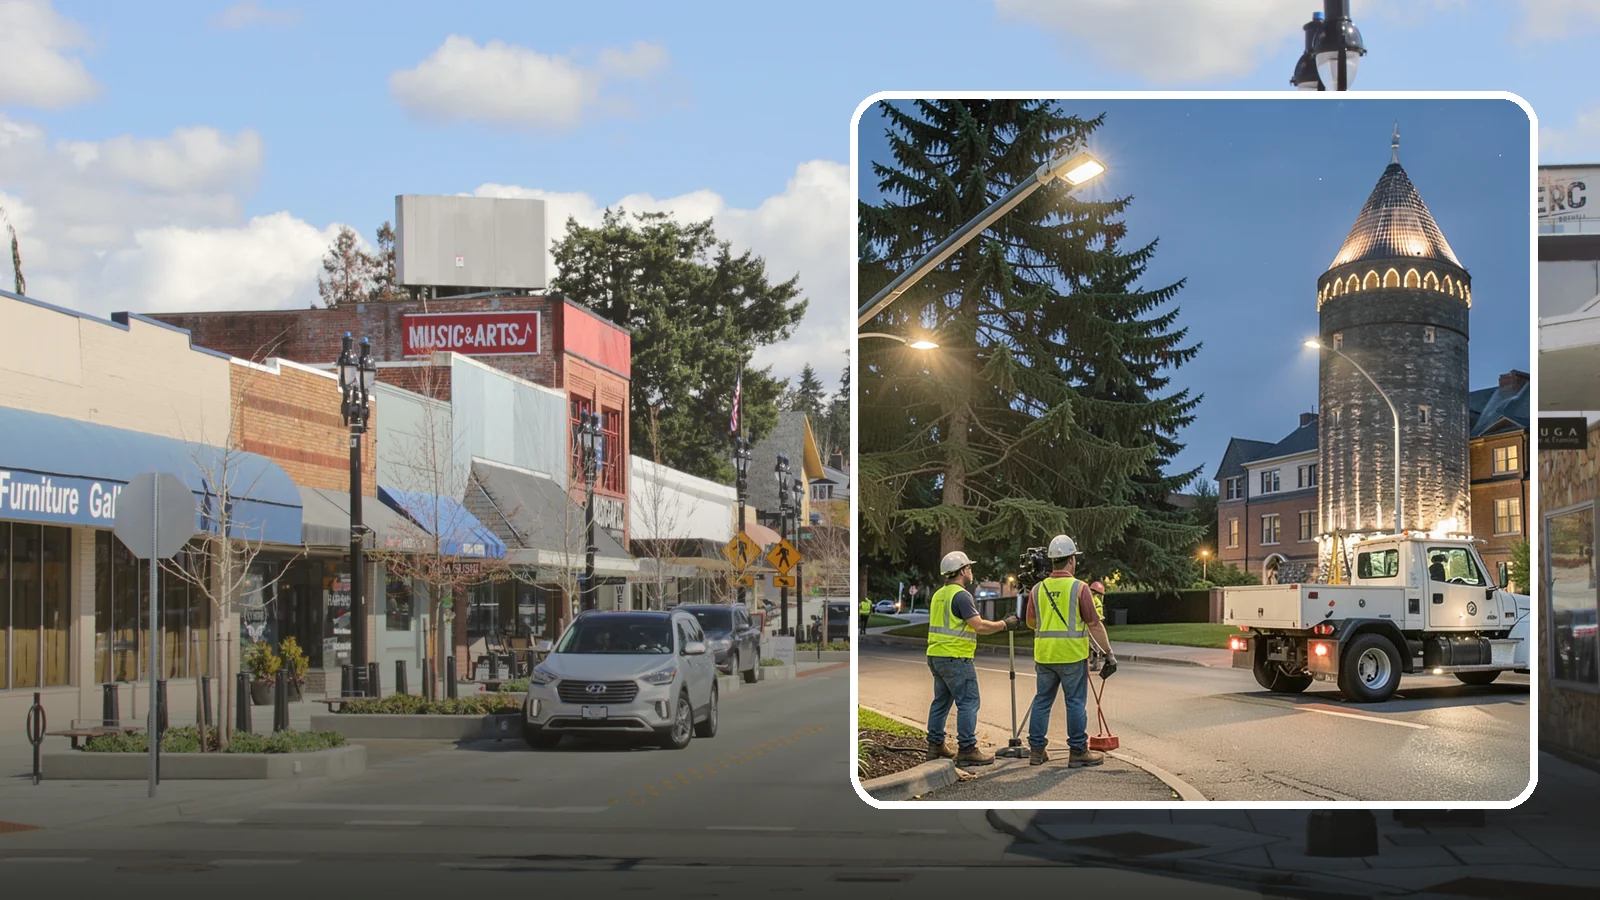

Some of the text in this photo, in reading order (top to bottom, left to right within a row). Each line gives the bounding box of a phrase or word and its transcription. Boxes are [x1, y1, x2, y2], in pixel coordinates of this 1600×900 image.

[0, 471, 122, 519] Furniture Gal
[453, 562, 480, 575] SUSHI
